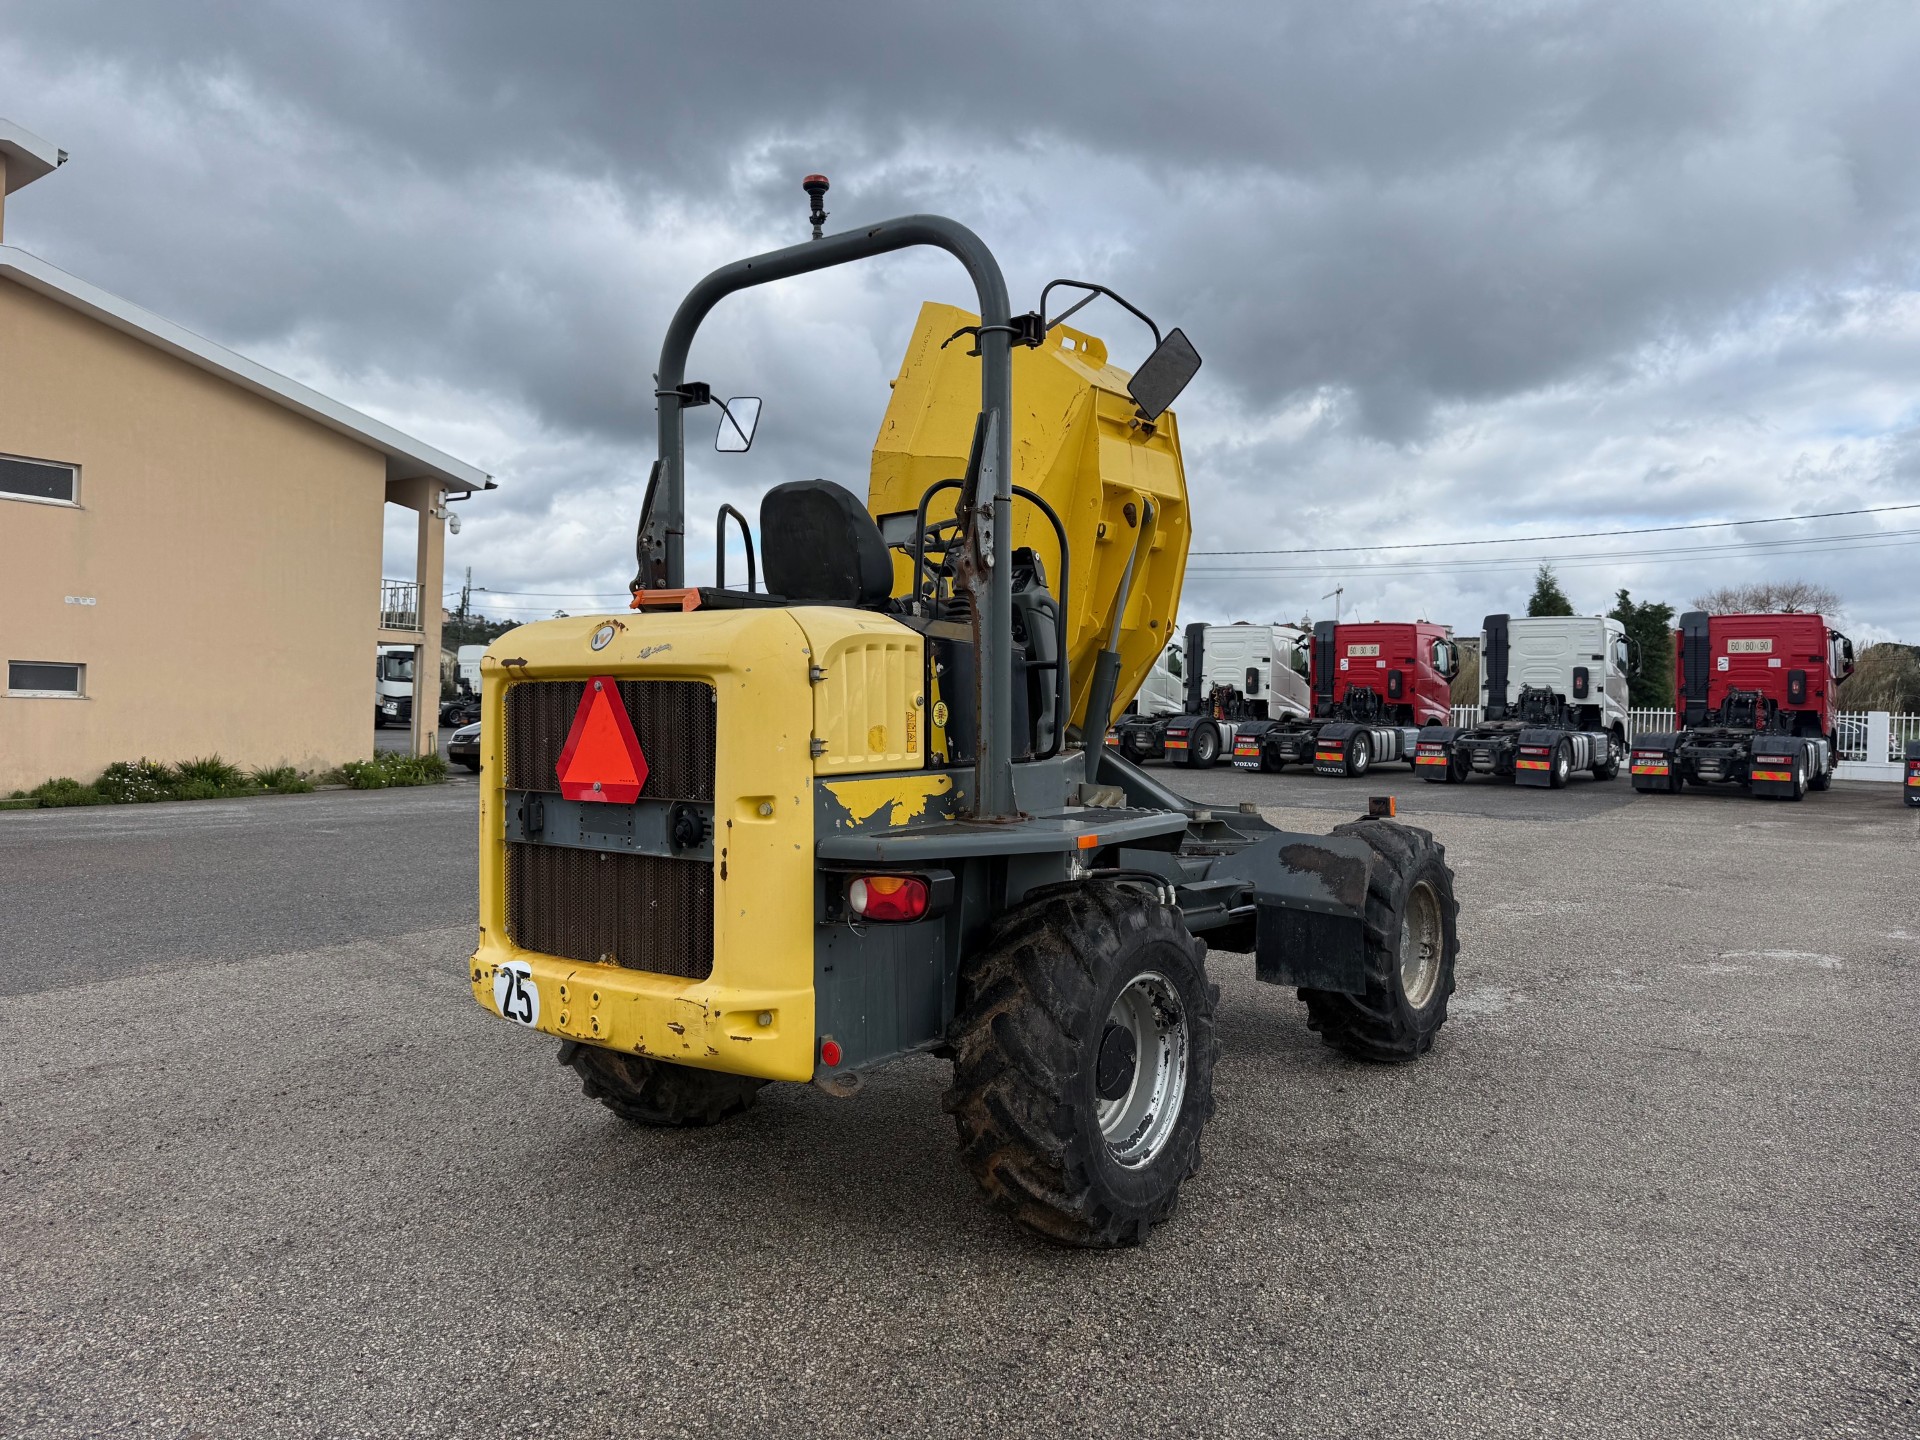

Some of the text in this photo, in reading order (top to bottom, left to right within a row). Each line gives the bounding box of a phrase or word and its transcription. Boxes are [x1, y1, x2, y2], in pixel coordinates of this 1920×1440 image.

[1730, 641, 1769, 651] 60 80 90
[1316, 766, 1344, 774] VOLVO
[501, 966, 533, 1024] 25
